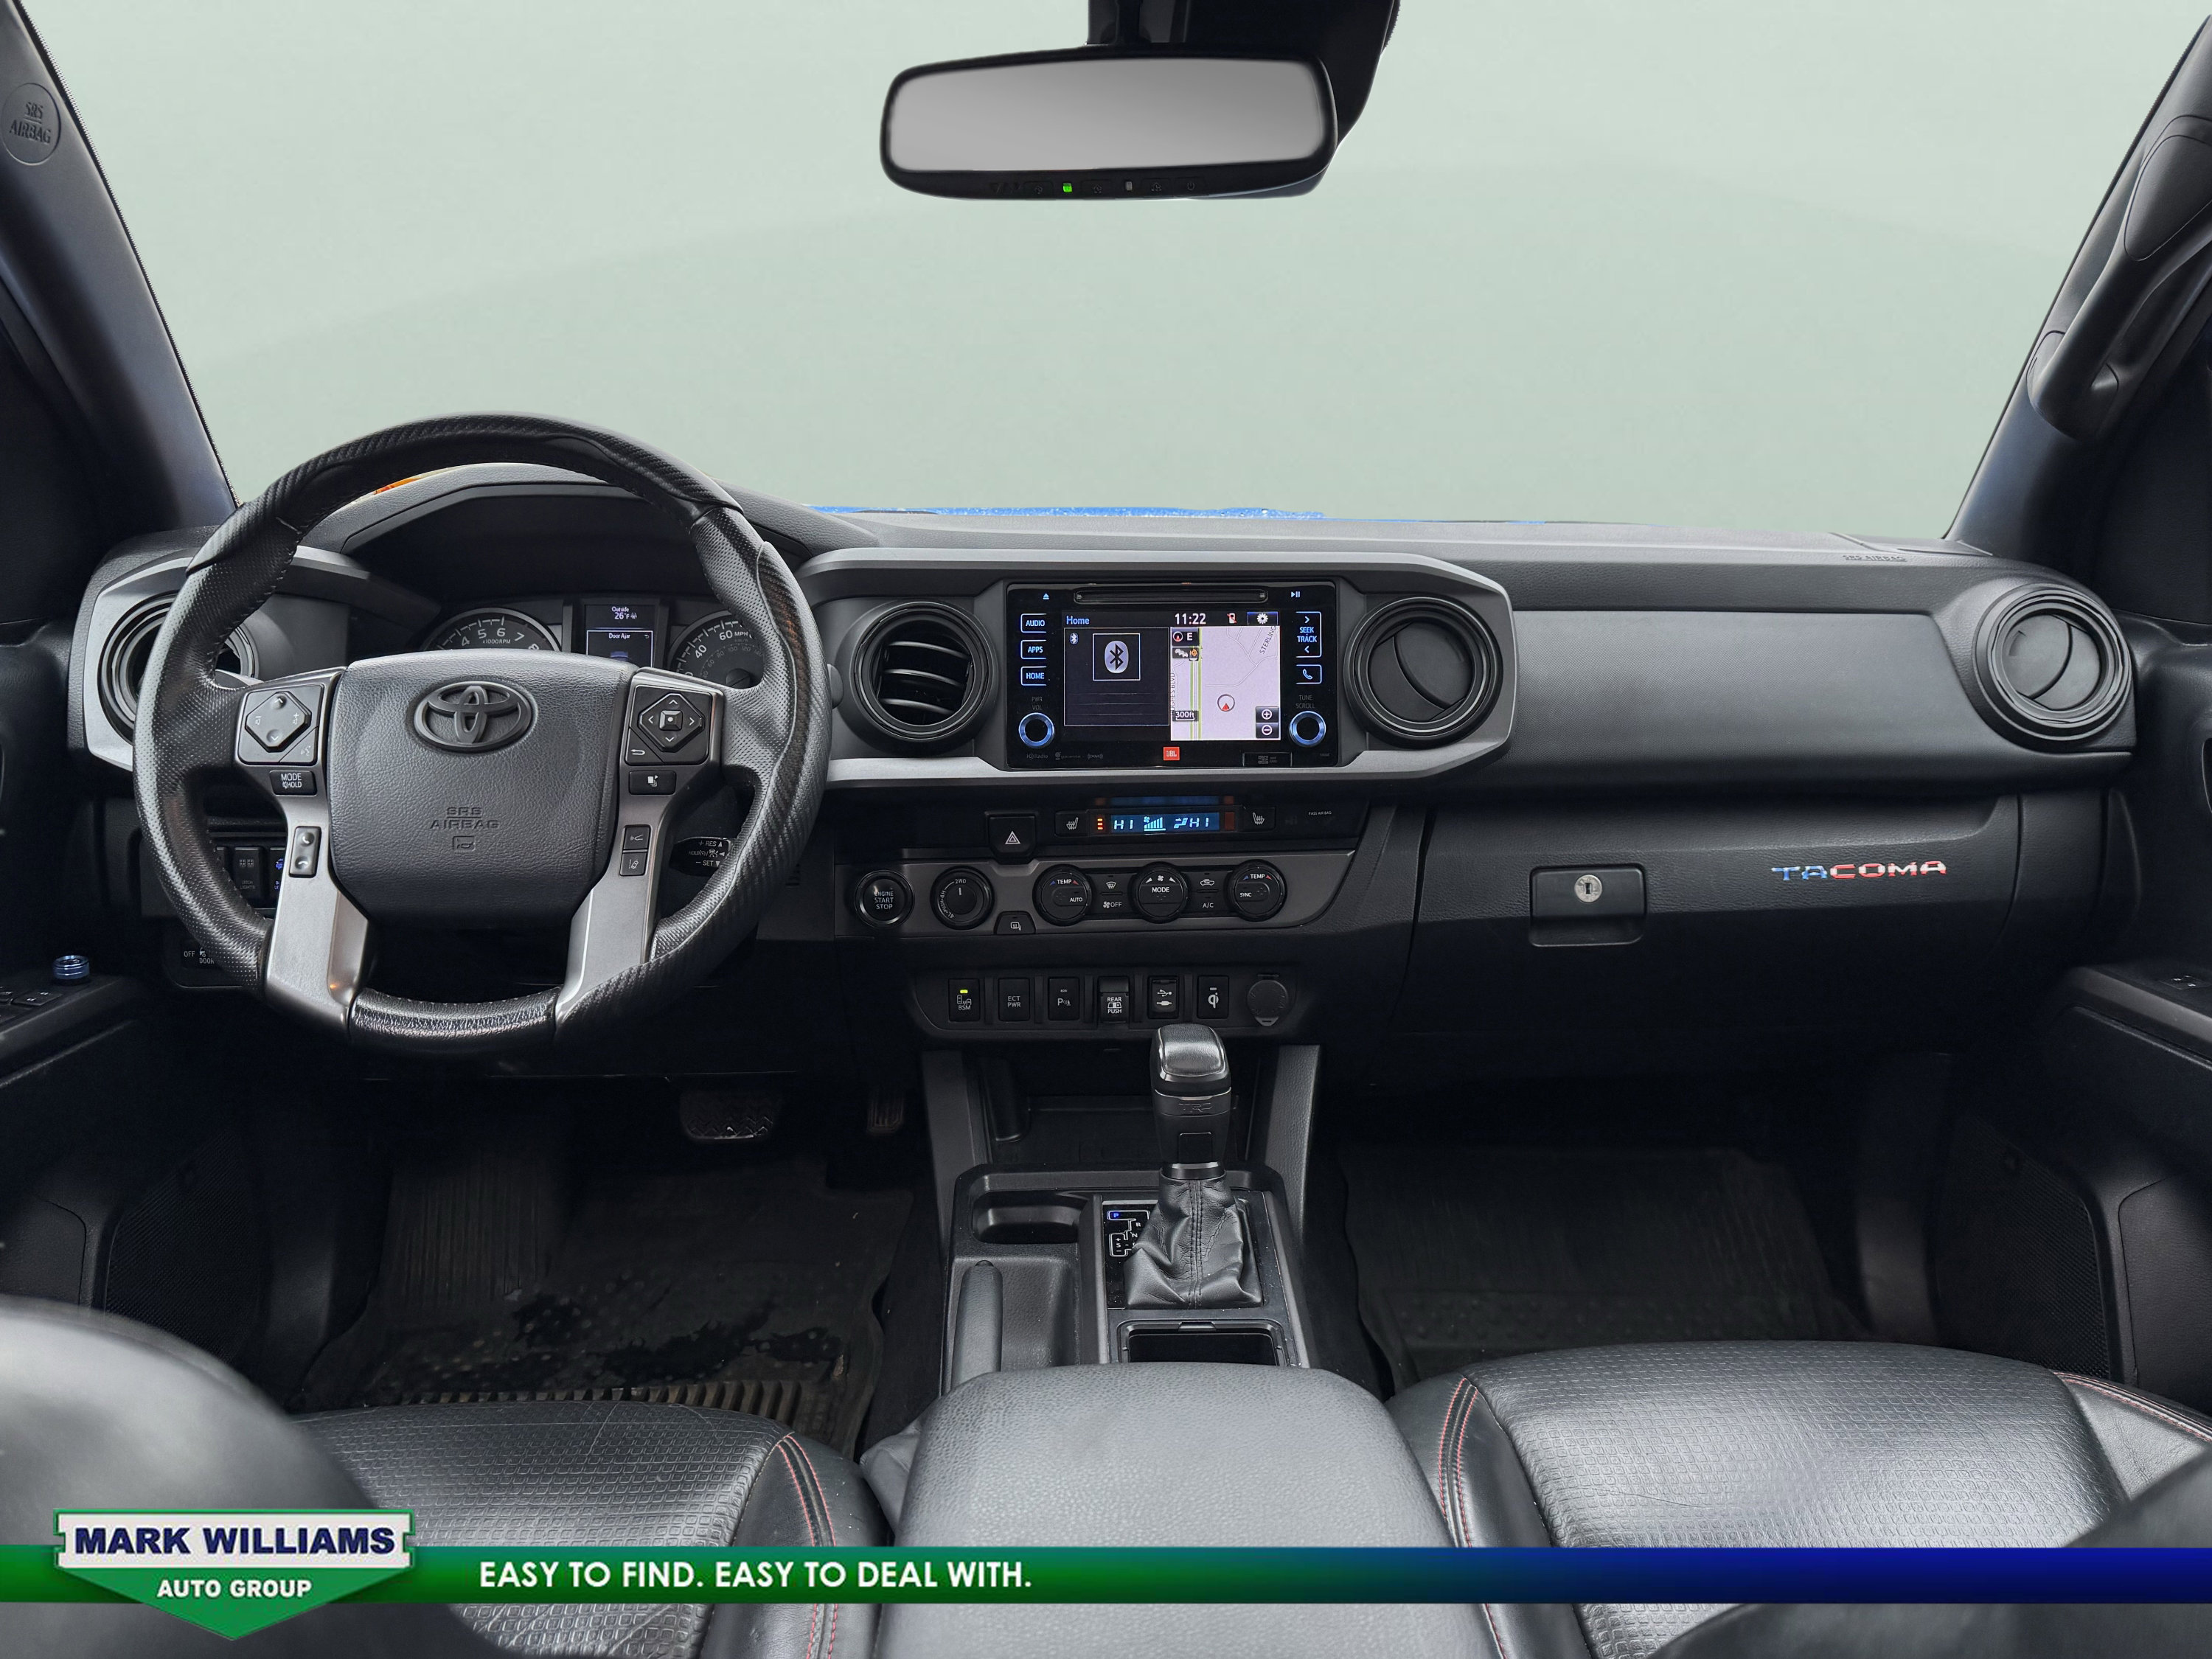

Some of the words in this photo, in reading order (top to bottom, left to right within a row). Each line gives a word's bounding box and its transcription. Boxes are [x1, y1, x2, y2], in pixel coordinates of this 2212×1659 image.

[25, 102, 44, 119] SRS
[10, 119, 51, 145] AIRBAG
[1066, 615, 1090, 625] Home
[1175, 613, 1206, 625] 11:22
[478, 628, 487, 639] 5
[496, 627, 506, 637] 6
[515, 632, 524, 641] 7
[719, 630, 733, 641] 60
[1186, 632, 1193, 641] E
[1259, 625, 1277, 655] STERLING
[1297, 635, 1318, 643] TRACK
[695, 644, 707, 658] 40
[280, 773, 302, 781] MODE
[447, 807, 482, 815] SRS
[430, 819, 500, 829] AIRBAG
[1771, 860, 1947, 881] TACOMA
